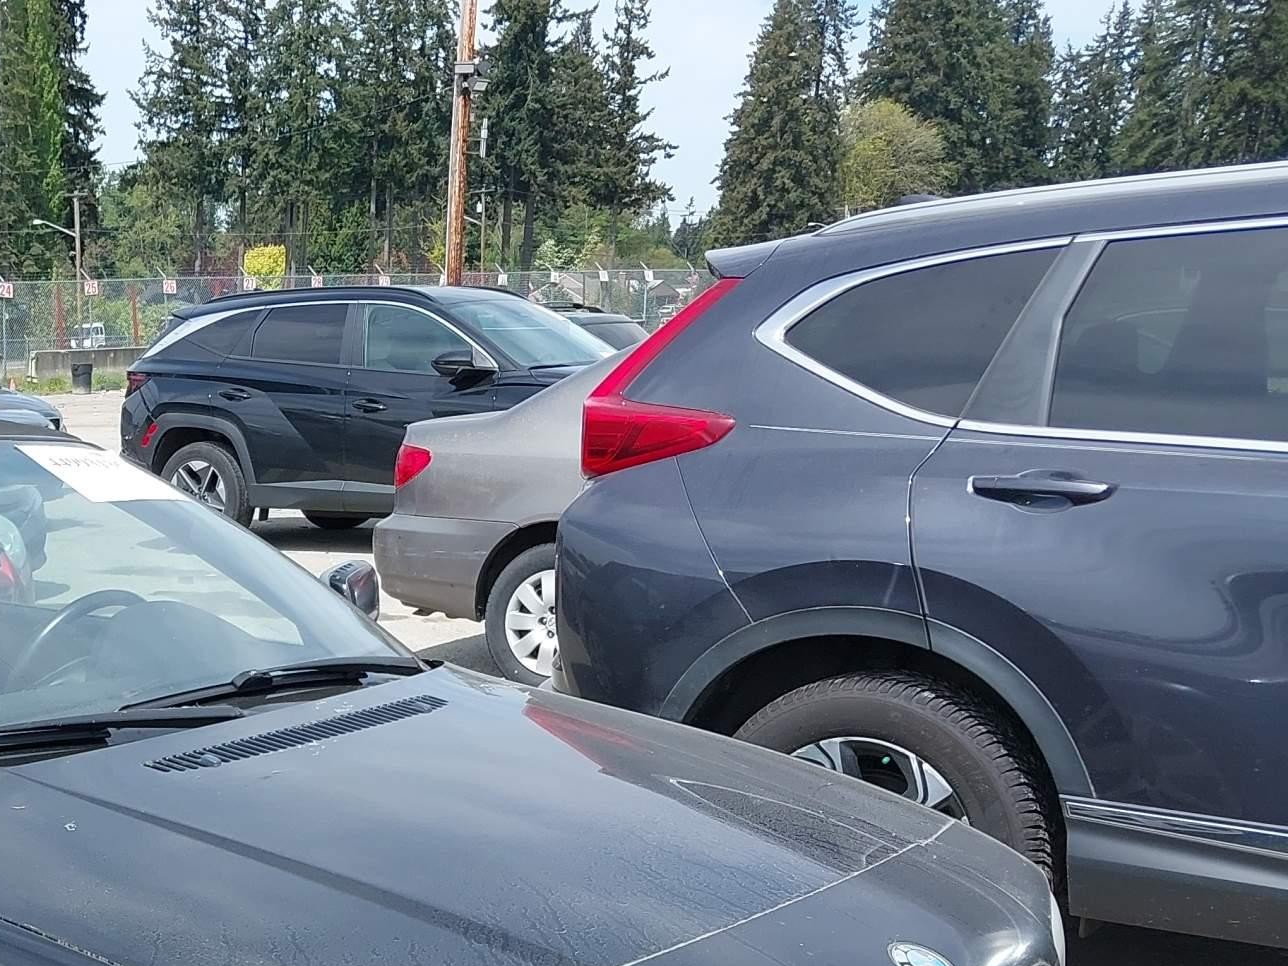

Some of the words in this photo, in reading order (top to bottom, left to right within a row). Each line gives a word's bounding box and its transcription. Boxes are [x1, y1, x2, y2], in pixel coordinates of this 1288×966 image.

[0, 284, 11, 297] 24
[86, 283, 97, 295] 25
[165, 283, 175, 294] 26
